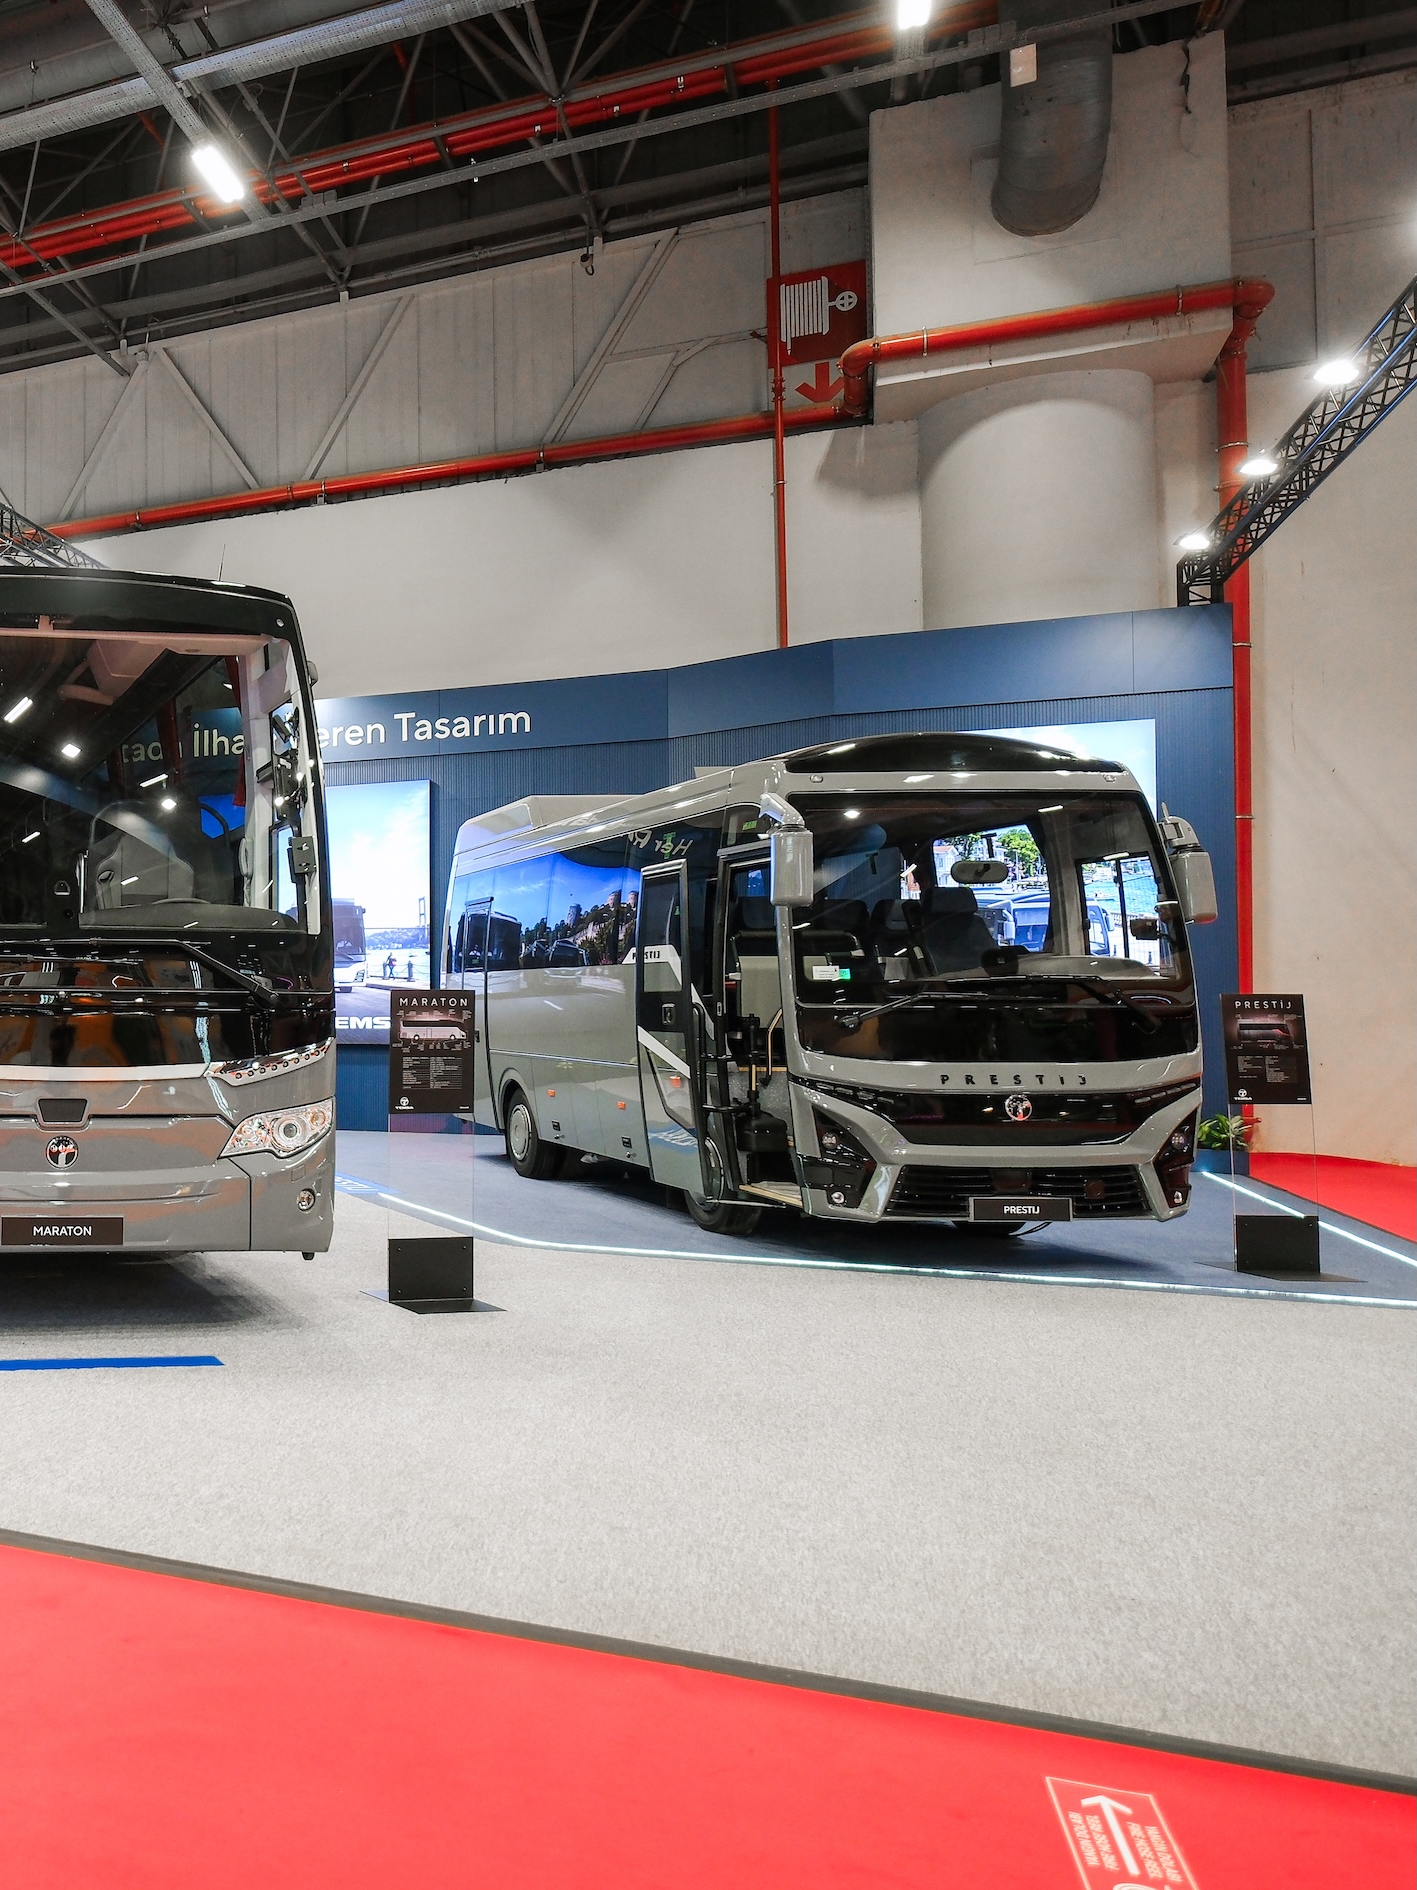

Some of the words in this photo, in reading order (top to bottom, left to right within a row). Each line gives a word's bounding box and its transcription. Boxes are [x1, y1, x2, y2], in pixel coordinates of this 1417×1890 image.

[194, 723, 244, 757] İlha
[319, 723, 386, 748] eren
[393, 711, 531, 742] Tasarım
[399, 998, 468, 1007] MARATON
[335, 1017, 391, 1029] EMS
[33, 1225, 92, 1237] MARATON
